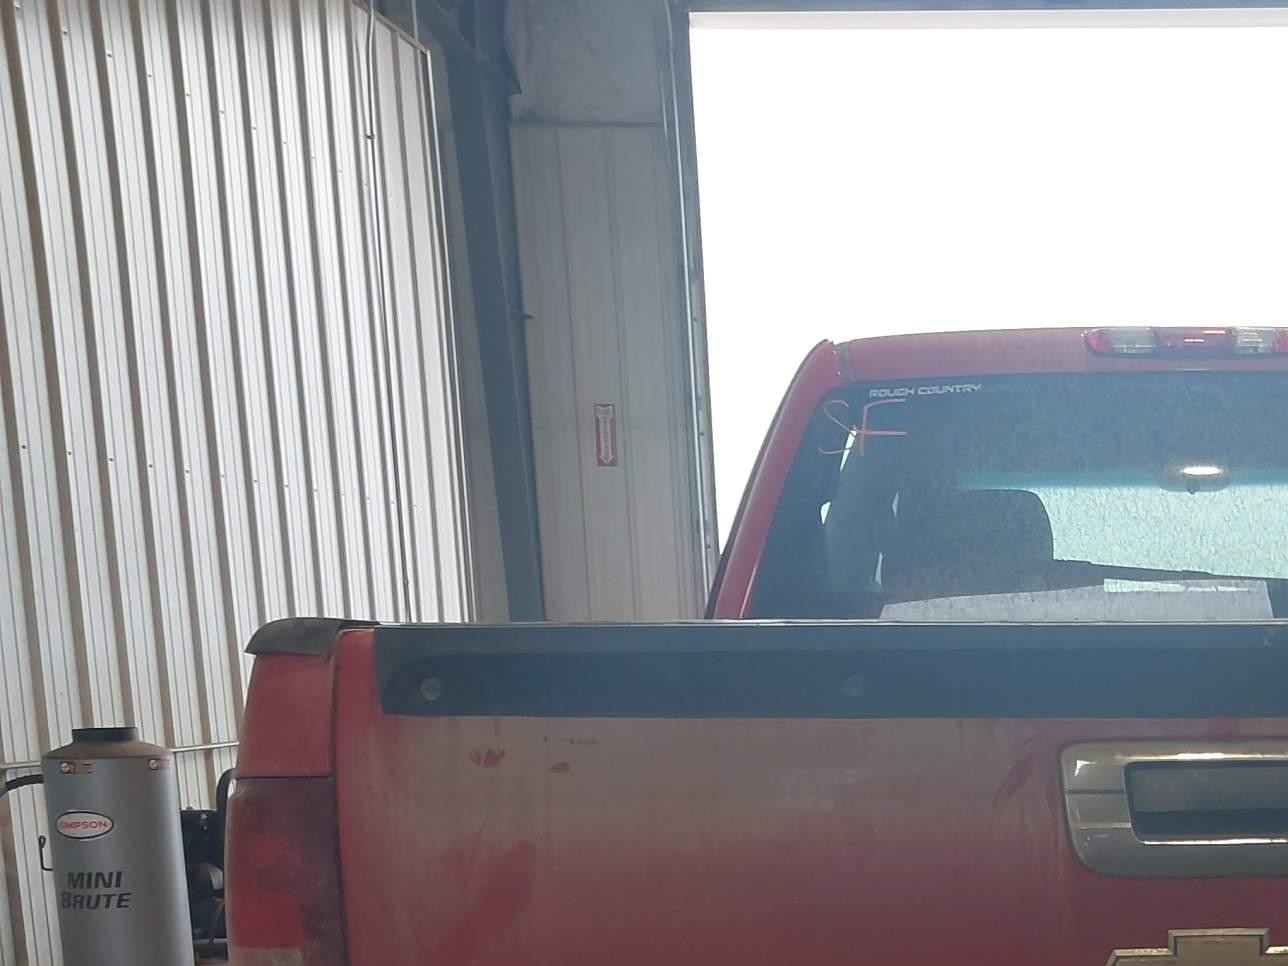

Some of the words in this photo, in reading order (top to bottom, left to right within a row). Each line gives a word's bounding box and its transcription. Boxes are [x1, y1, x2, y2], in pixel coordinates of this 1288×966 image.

[868, 387, 914, 398] ROUGH
[917, 383, 982, 396] COUNTRY
[67, 871, 123, 888] MINI
[61, 891, 132, 910] BRUTE
